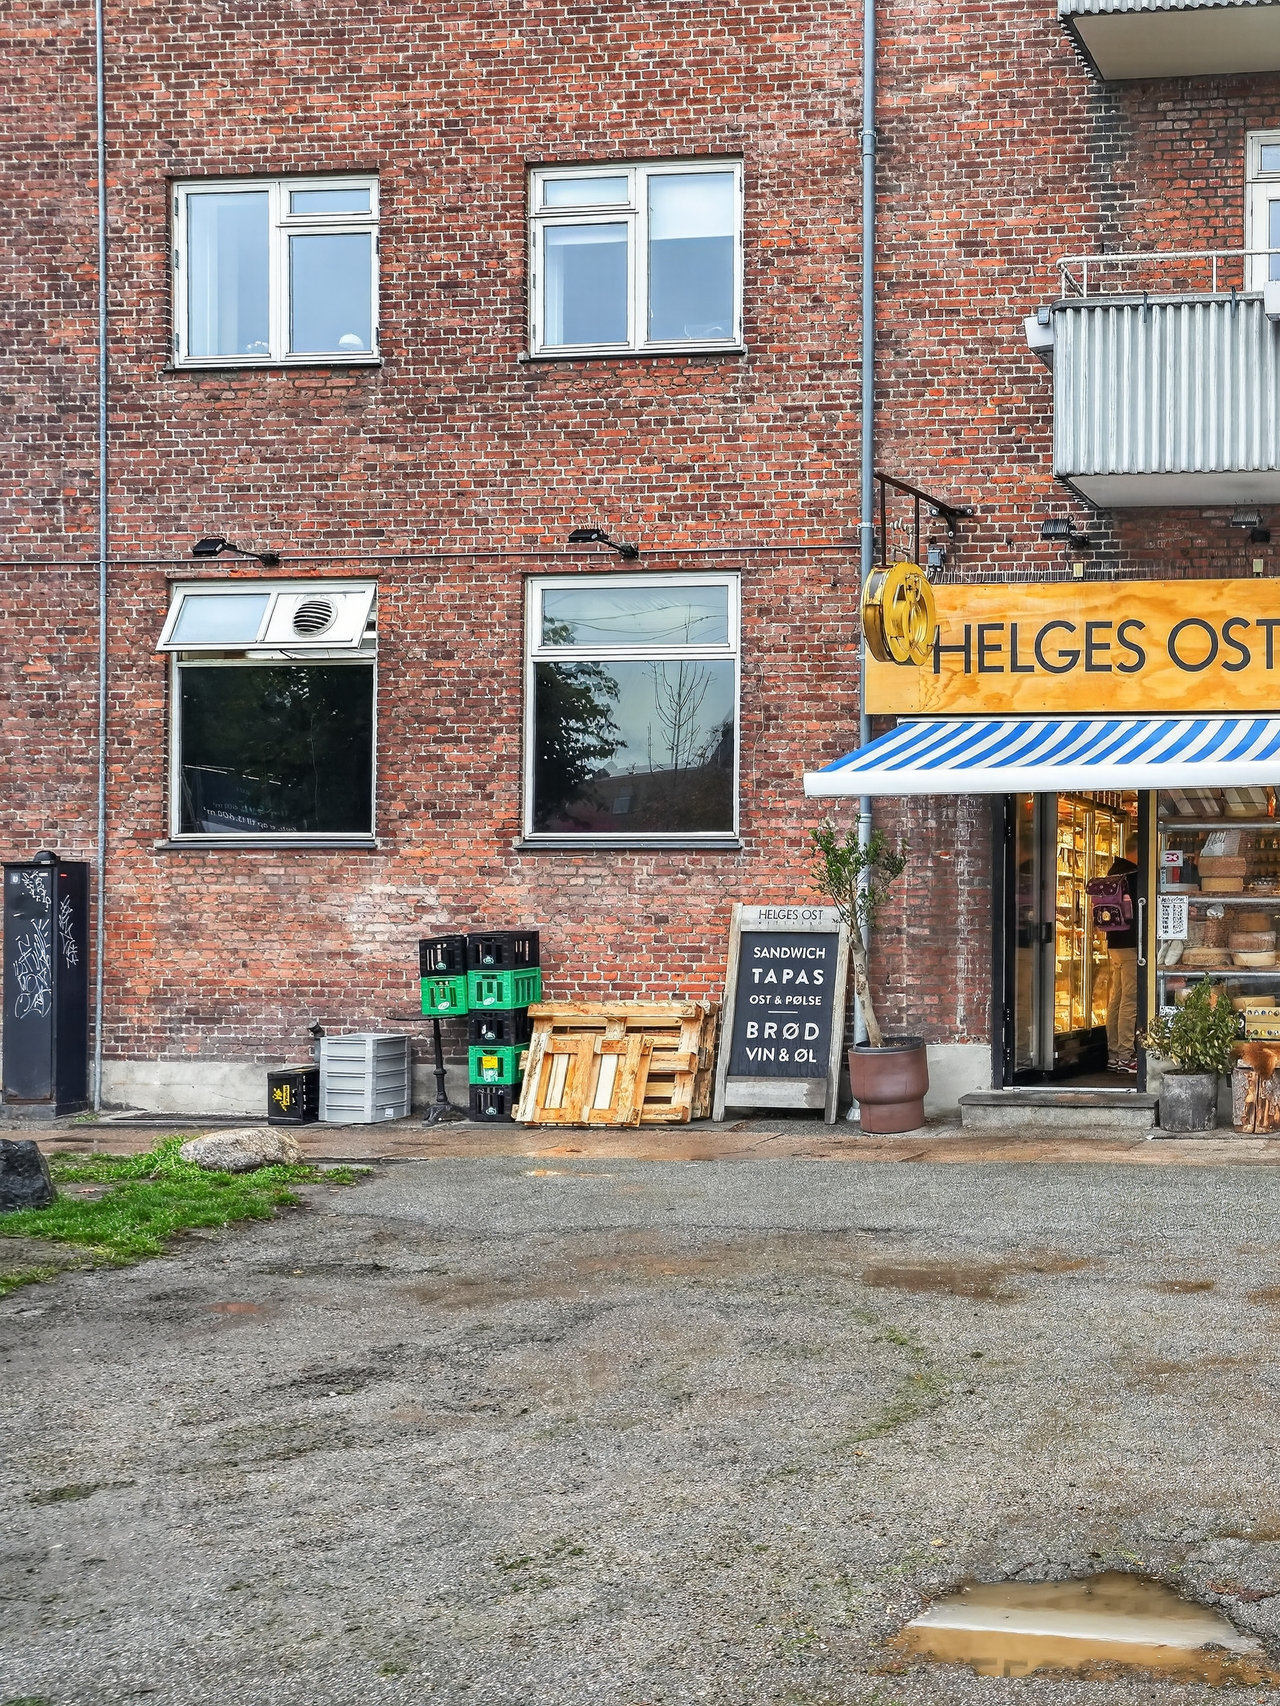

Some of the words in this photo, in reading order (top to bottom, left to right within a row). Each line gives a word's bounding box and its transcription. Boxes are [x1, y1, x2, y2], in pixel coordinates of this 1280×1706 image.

[933, 619, 1146, 675] HELGES
[758, 909, 799, 921] HELGES
[801, 909, 824, 921] OST
[753, 946, 826, 960] SANDWICH
[751, 968, 825, 986] TAPAS
[749, 995, 771, 1005] OST
[774, 995, 782, 1005] &
[785, 995, 822, 1006] PØLSE
[746, 1021, 820, 1041] BRØD
[745, 1047, 775, 1062] VIN
[778, 1047, 790, 1062] &
[794, 1048, 817, 1063] ØL
